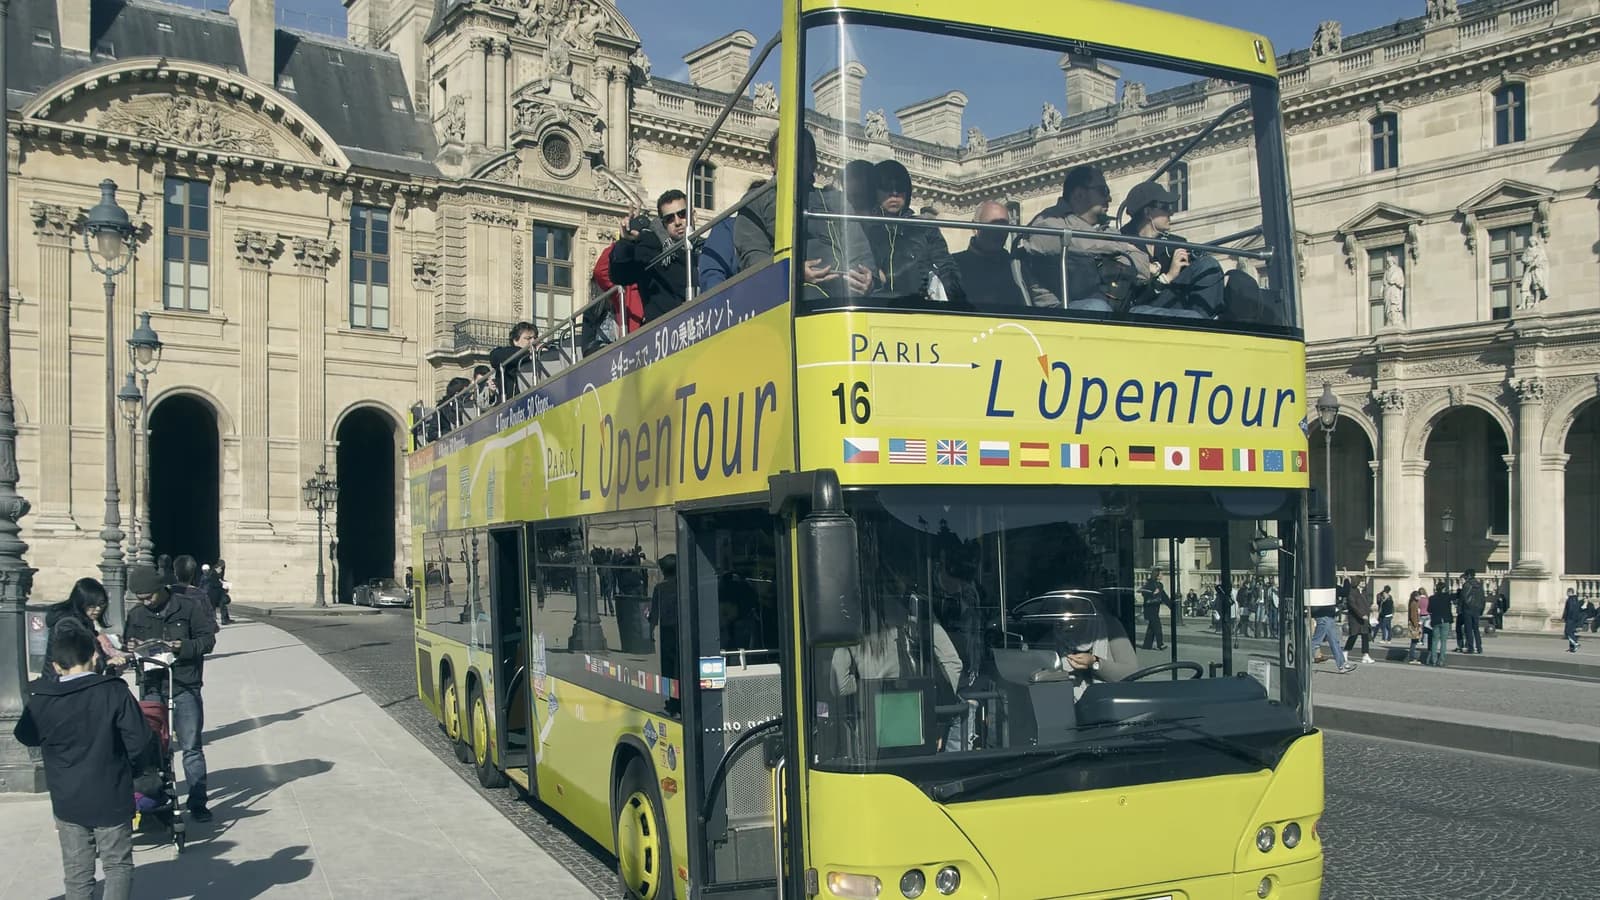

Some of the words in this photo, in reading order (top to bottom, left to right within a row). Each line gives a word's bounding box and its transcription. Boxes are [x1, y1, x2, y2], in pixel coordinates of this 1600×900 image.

[851, 333, 940, 364] PARIS
[832, 381, 871, 425] 16
[547, 447, 575, 480] PARIS
